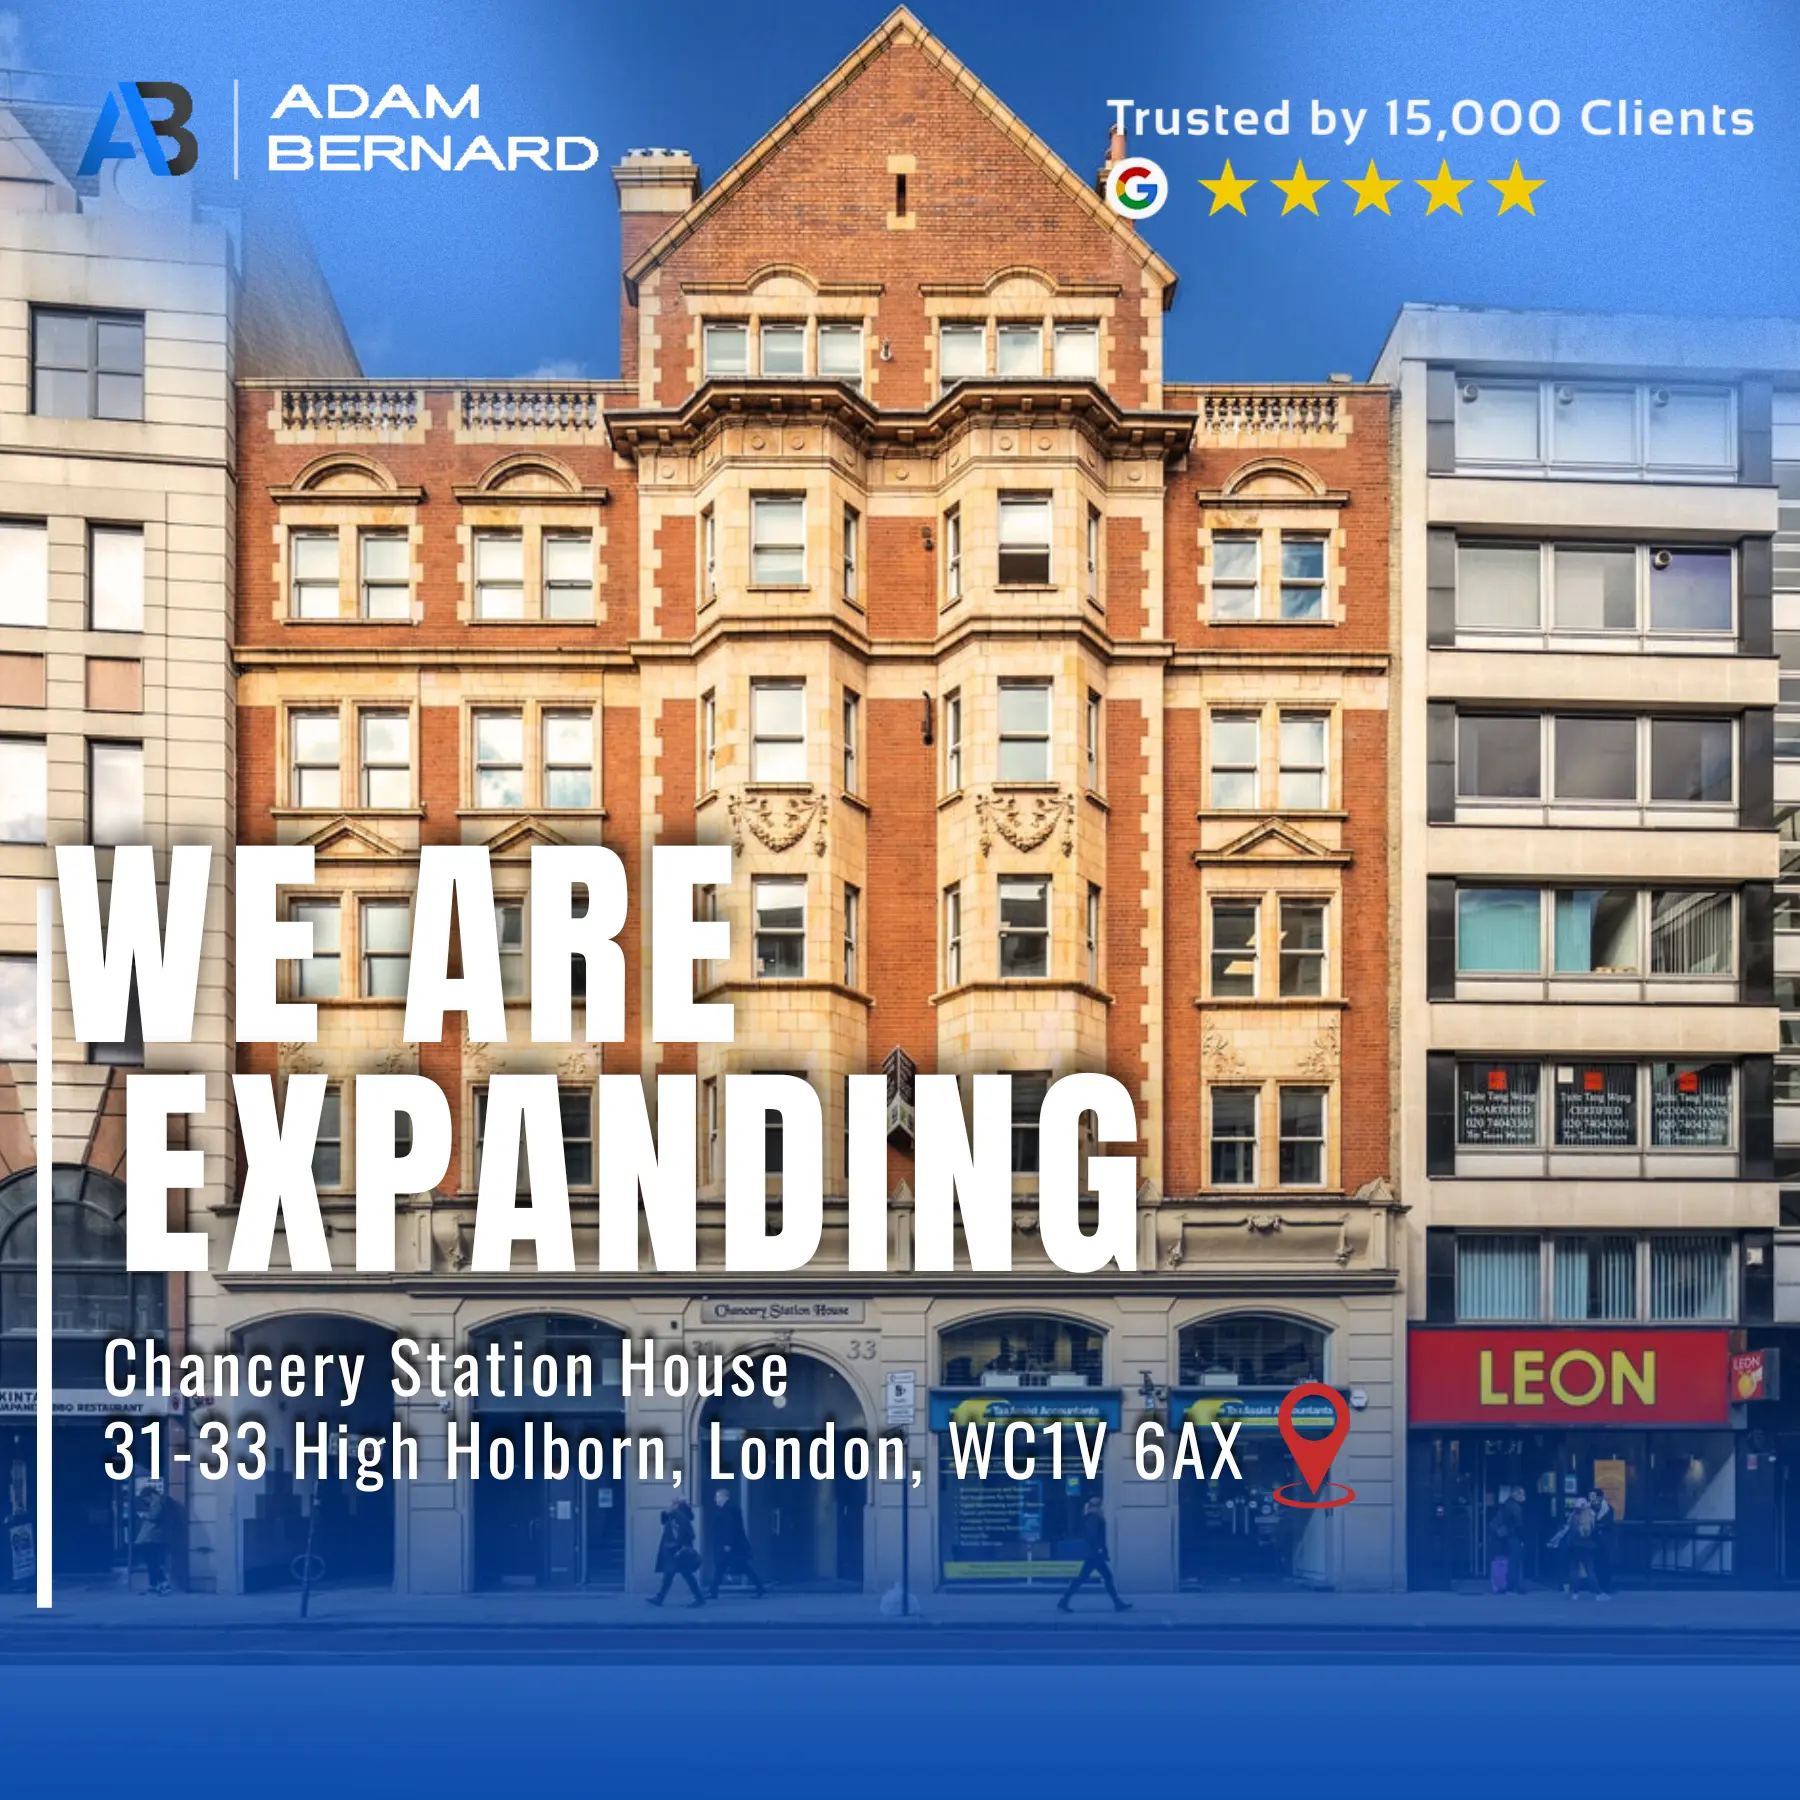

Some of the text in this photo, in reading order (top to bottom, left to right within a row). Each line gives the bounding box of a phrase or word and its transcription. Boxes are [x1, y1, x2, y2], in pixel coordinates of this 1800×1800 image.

[714, 1304, 849, 1320] Chancery Station House
[846, 1339, 877, 1361] 33
[1733, 1356, 1760, 1370] LEON
[1480, 1349, 1657, 1406] LEON
[77, 1403, 144, 1413] RESTAURANT
[1040, 1405, 1100, 1416] Accountants
[1273, 1405, 1334, 1416] Aountants
